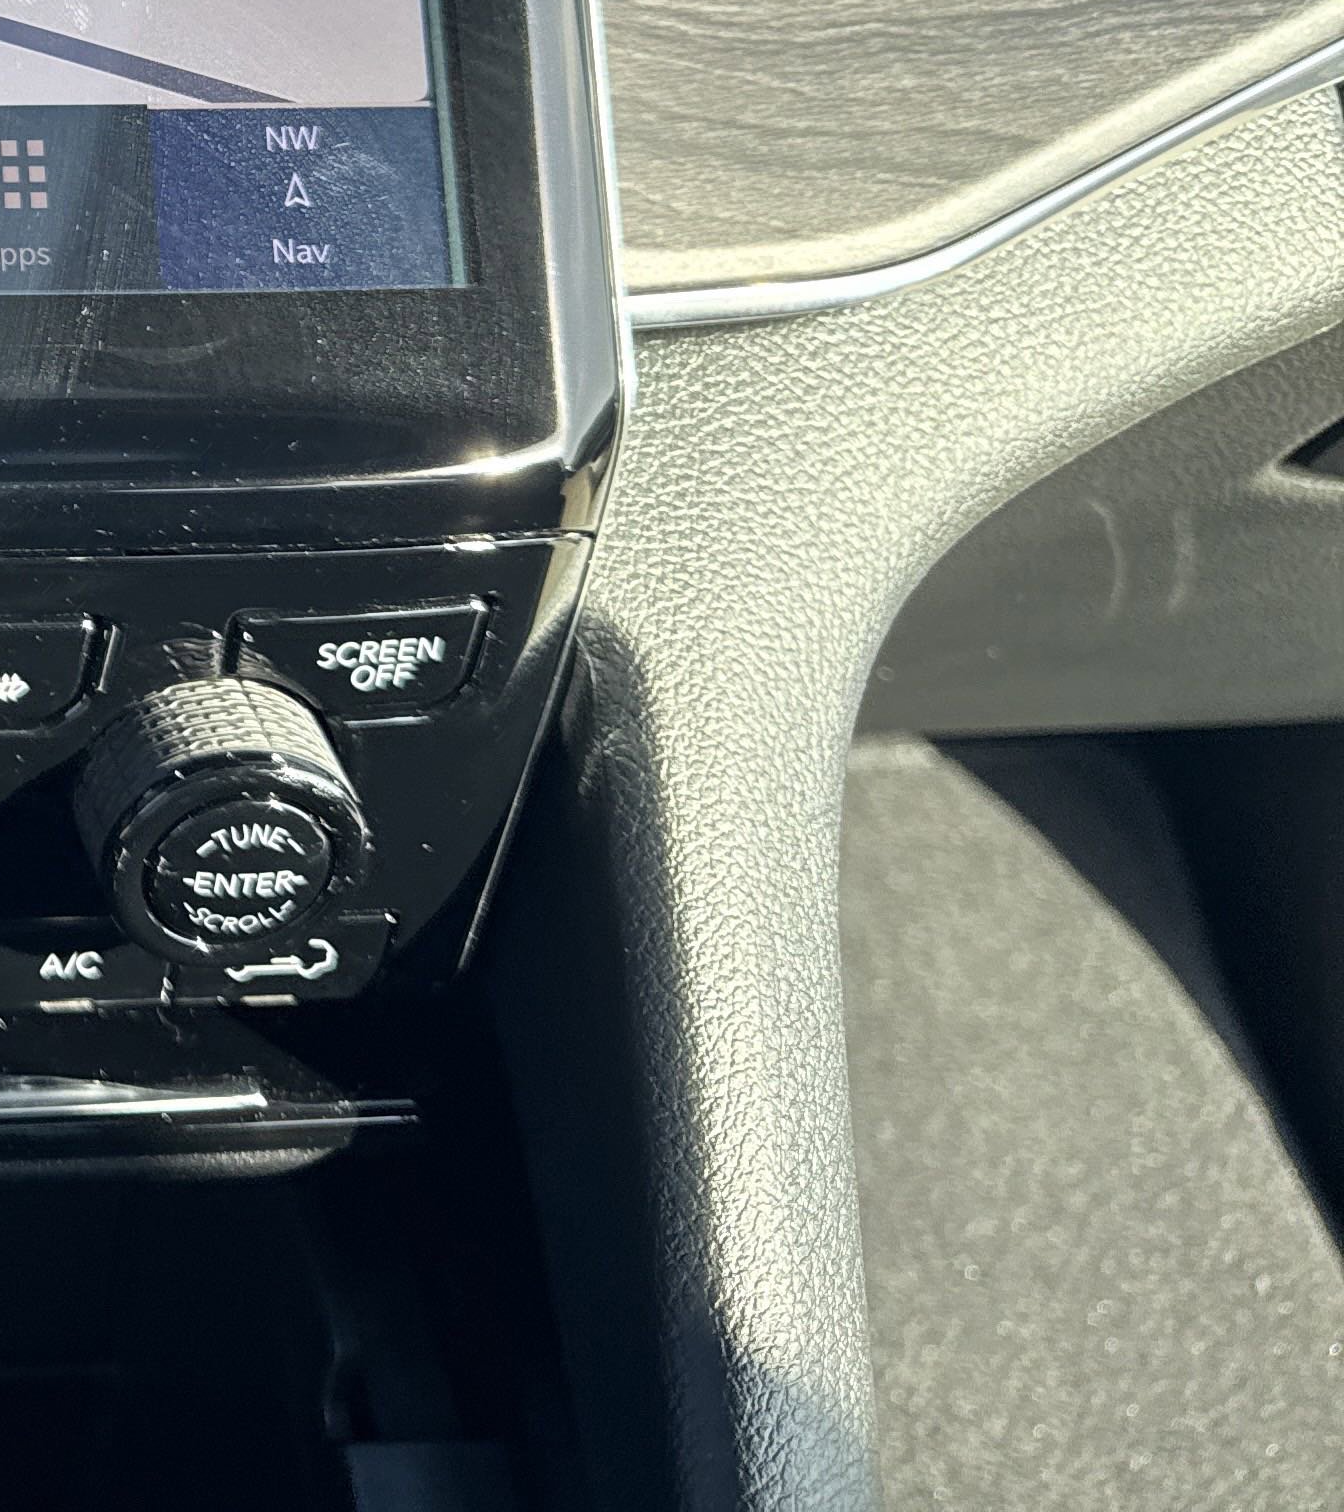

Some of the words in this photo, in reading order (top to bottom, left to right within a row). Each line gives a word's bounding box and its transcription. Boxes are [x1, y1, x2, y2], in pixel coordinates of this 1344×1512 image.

[265, 127, 318, 150] NW
[272, 239, 331, 264] Nav
[317, 635, 444, 668] SCREEN
[350, 664, 420, 691] OFF
[211, 823, 292, 854] TUNE
[193, 870, 296, 898] ENTER
[40, 951, 103, 981] A/C
